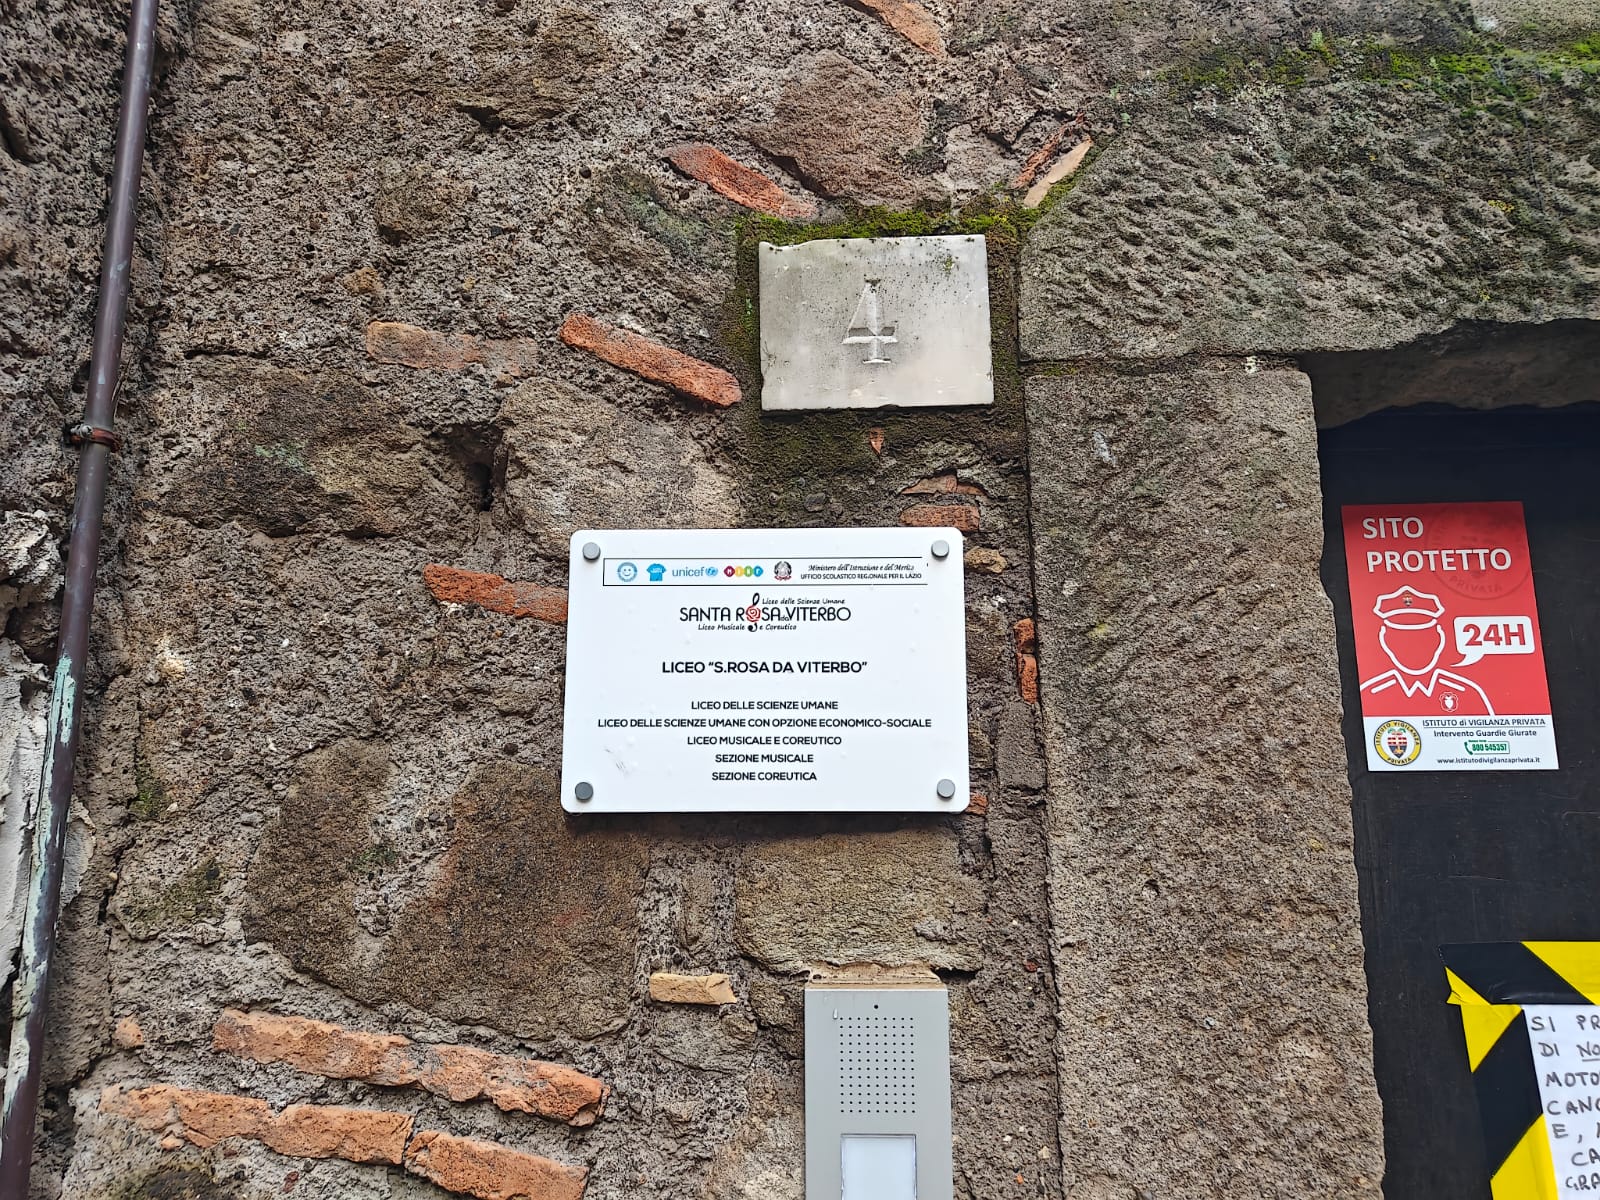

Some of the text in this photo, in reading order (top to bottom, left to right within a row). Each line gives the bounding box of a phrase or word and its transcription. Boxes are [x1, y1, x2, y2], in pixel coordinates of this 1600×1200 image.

[841, 278, 899, 364] 4
[1362, 516, 1424, 539] SITO
[1366, 548, 1512, 573] PROTETTO
[671, 566, 705, 577] unicef
[808, 564, 836, 572] Ministero
[884, 563, 894, 571] del
[894, 564, 915, 572] Merito
[762, 597, 778, 605] Liceo
[780, 597, 795, 605] delle
[797, 597, 820, 605] Scienze
[679, 606, 731, 622] SANTA
[785, 606, 852, 622] VITERBO
[1462, 623, 1526, 647] 24H
[661, 661, 706, 674] LICEO
[772, 661, 794, 674] DA
[691, 700, 839, 710] LICEO DELLE SCIENZE UMANE
[597, 718, 932, 728] LICEO DELLE SCIENZE UMANE CON OPZIONE ECONOMICO-SOCIALE
[1422, 718, 1546, 727] ISTITUTO di VIGILANZA PRIVATA
[1433, 729, 1537, 737] Intervento Guardie Giurate
[687, 736, 842, 745] LICEO MUSICALE E COREUTICO
[715, 753, 814, 763] SEZIONE MUSICALE
[1437, 757, 1541, 765] www.istitutodivigilanzaprivata.it
[711, 771, 817, 781] SEZIONE COREUTICA
[1531, 1015, 1556, 1033] SI
[1538, 1042, 1561, 1057] DI
[1545, 1071, 1600, 1088] MOTO
